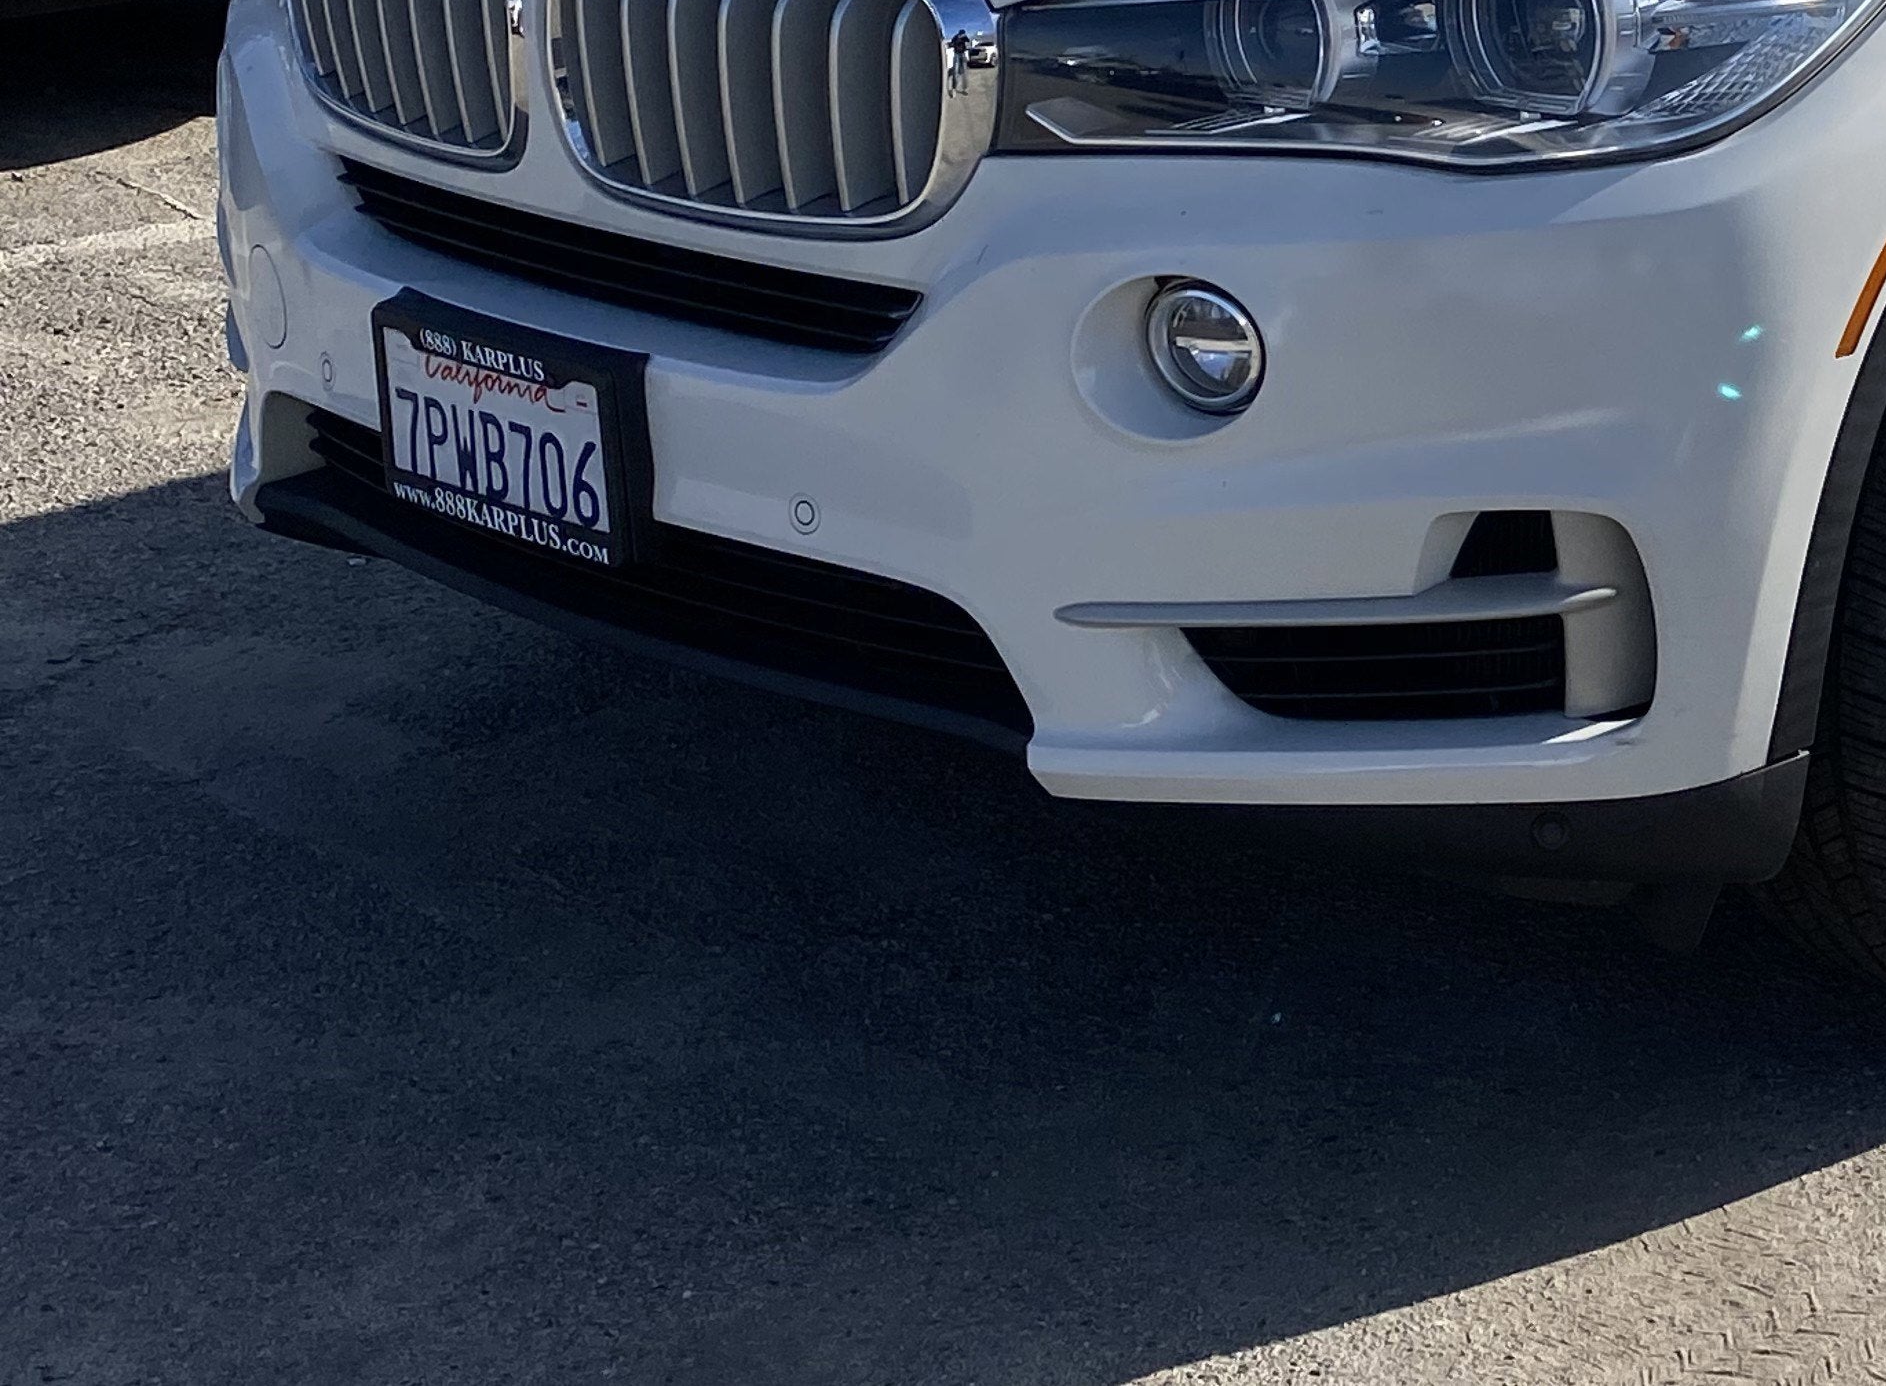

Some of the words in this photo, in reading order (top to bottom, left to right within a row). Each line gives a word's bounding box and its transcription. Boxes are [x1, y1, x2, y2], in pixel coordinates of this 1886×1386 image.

[419, 327, 458, 357] (888)
[460, 340, 545, 382] KARPLUS
[394, 387, 600, 529] 7PWB706
